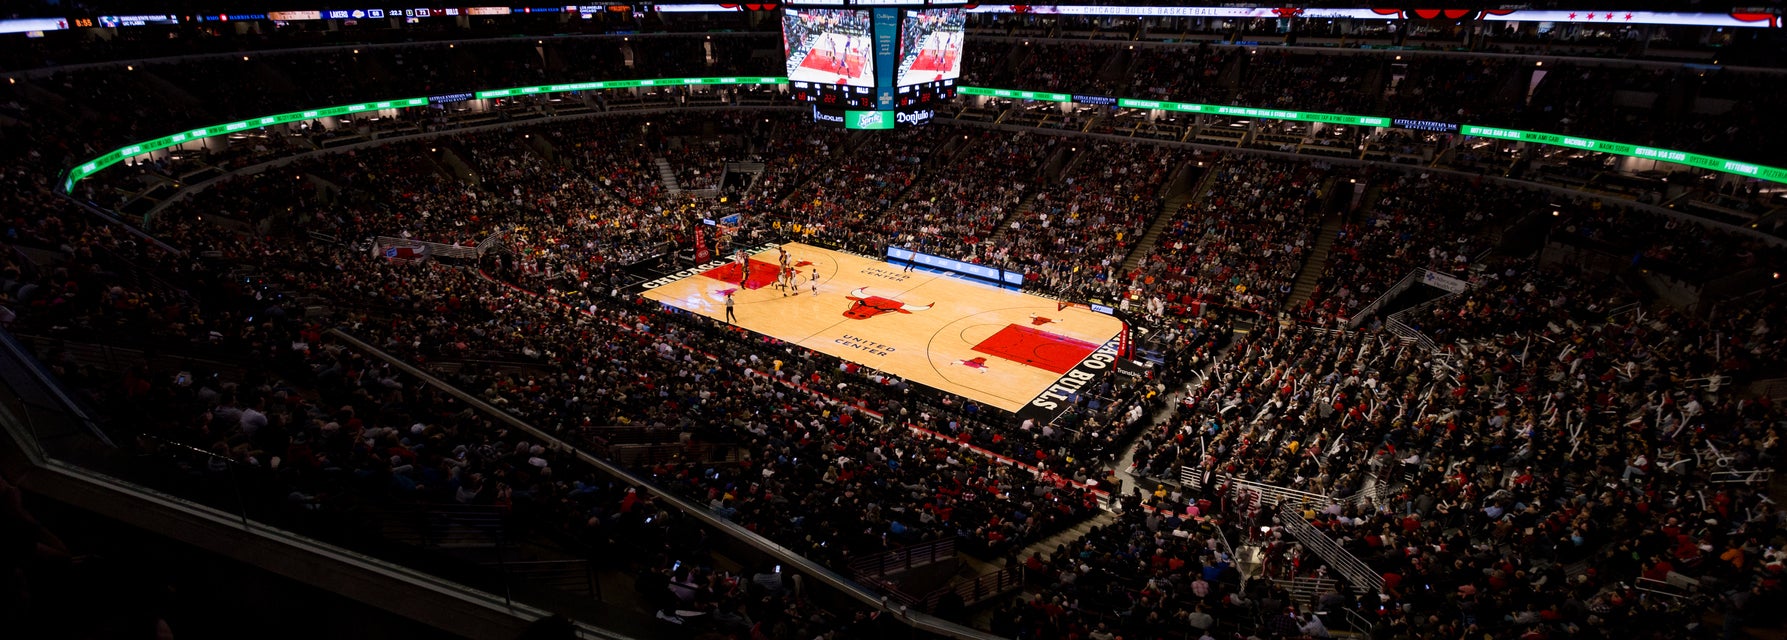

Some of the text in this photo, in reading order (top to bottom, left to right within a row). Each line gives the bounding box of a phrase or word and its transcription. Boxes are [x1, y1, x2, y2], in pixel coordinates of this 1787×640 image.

[330, 10, 348, 18] LAKERS
[1084, 7, 1119, 15] CHICAGO
[1158, 8, 1218, 16] BASKETBALL
[641, 258, 726, 289] CHICAGO
[861, 270, 904, 283] CENTER
[868, 267, 910, 279] UNITED
[835, 339, 887, 357] CENTER
[843, 334, 895, 352] UNITED
[1031, 369, 1095, 411] BULLS
